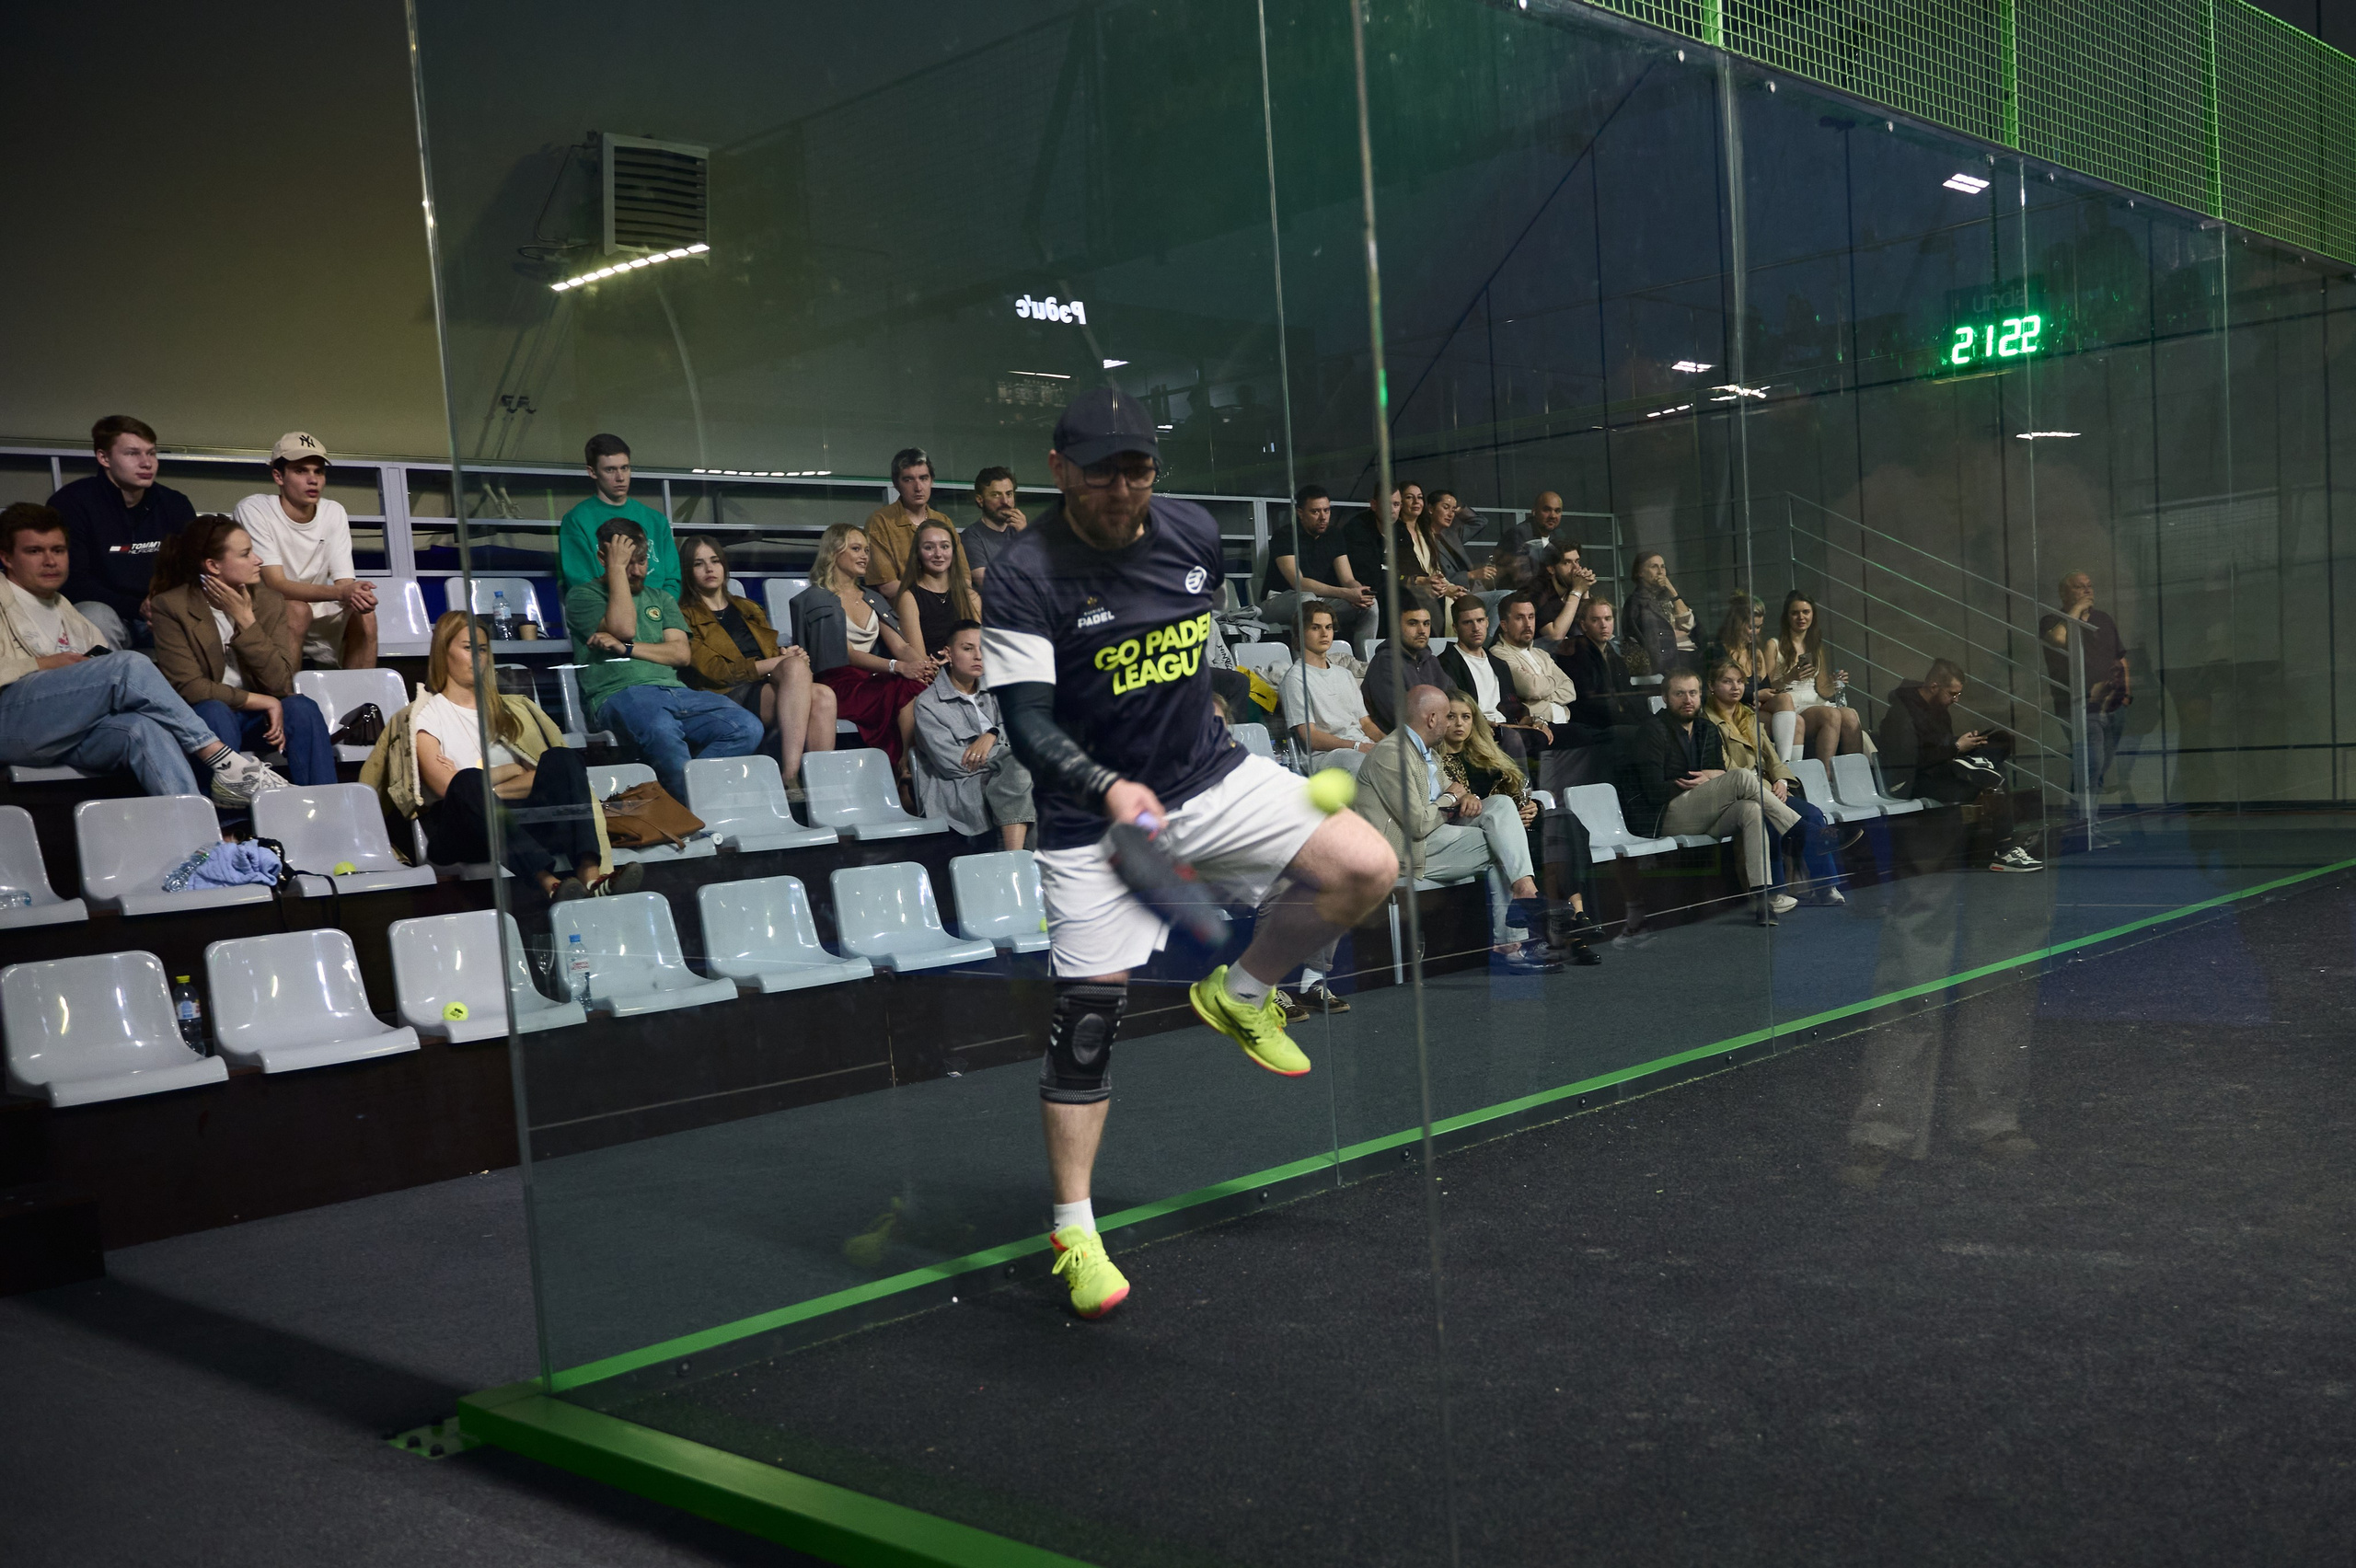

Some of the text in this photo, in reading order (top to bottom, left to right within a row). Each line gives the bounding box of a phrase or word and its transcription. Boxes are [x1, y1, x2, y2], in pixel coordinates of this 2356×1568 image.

[1077, 610, 1115, 629] PADEL
[1093, 638, 1141, 672] GO
[1112, 642, 1204, 697] LEAGU
